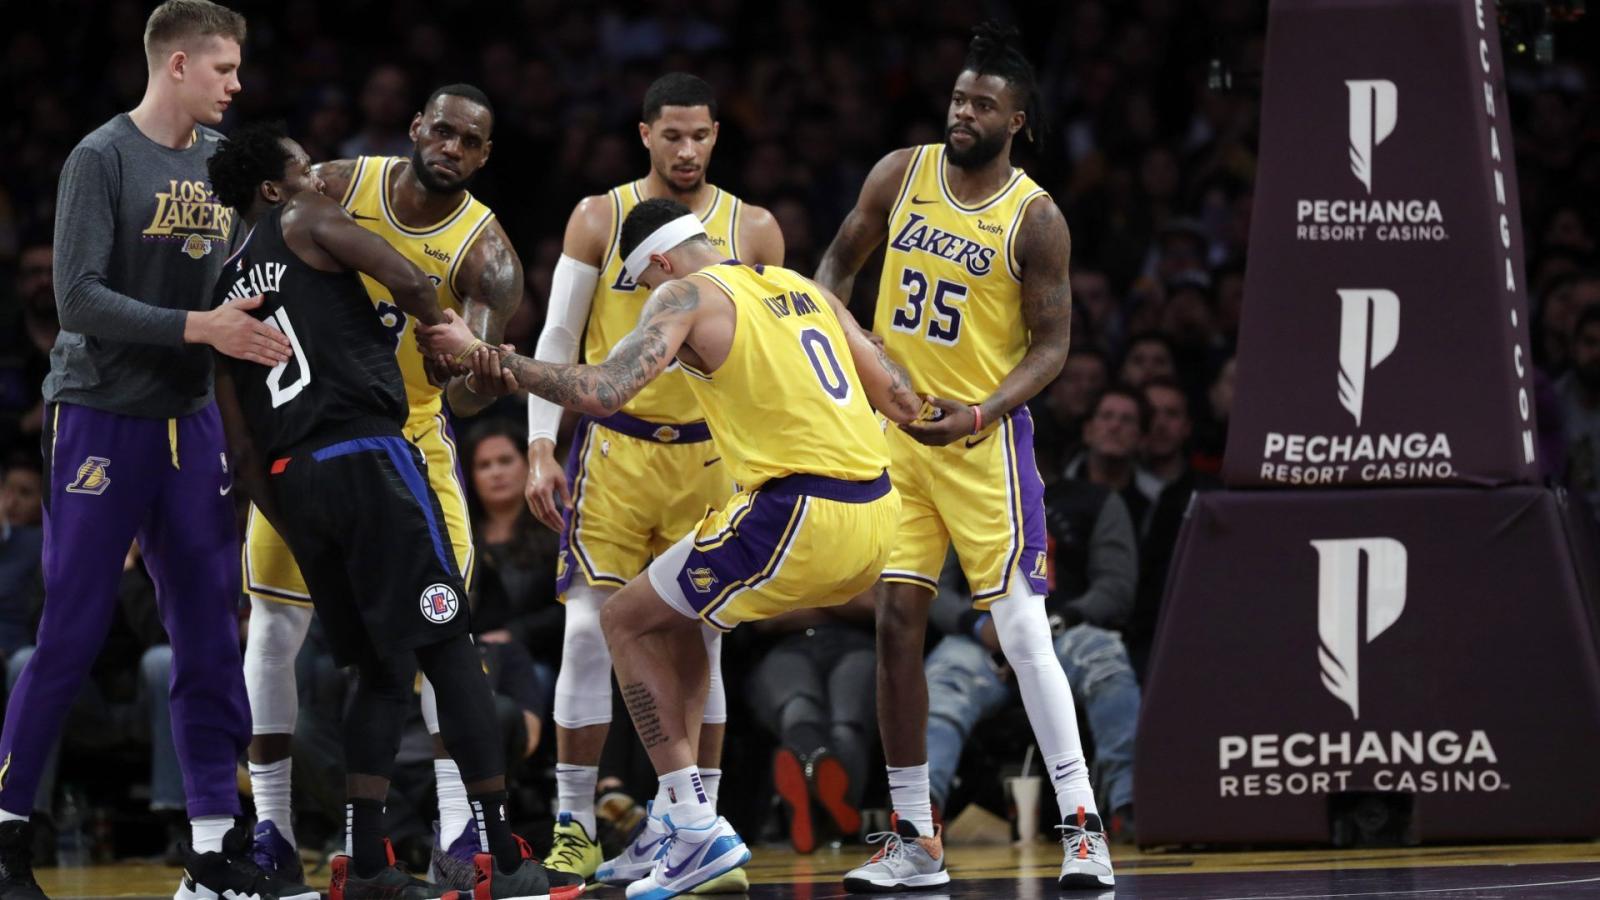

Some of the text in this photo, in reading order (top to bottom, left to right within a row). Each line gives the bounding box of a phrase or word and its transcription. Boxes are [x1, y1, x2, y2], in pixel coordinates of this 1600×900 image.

[169, 180, 206, 203] LOS
[142, 192, 234, 240] LAKERS
[1297, 200, 1443, 223] PECHANGA
[977, 219, 1004, 236] wish
[1297, 224, 1367, 240] RESORT
[423, 243, 452, 263] wish
[709, 236, 726, 246] ish
[891, 212, 997, 277] LAKERS
[892, 267, 968, 347] 35
[800, 327, 850, 407] 0
[1264, 432, 1452, 463] PECHANGA
[1260, 462, 1348, 484] RESORT
[1219, 730, 1498, 770] PECHANGA
[1220, 771, 1352, 797] RESORT
